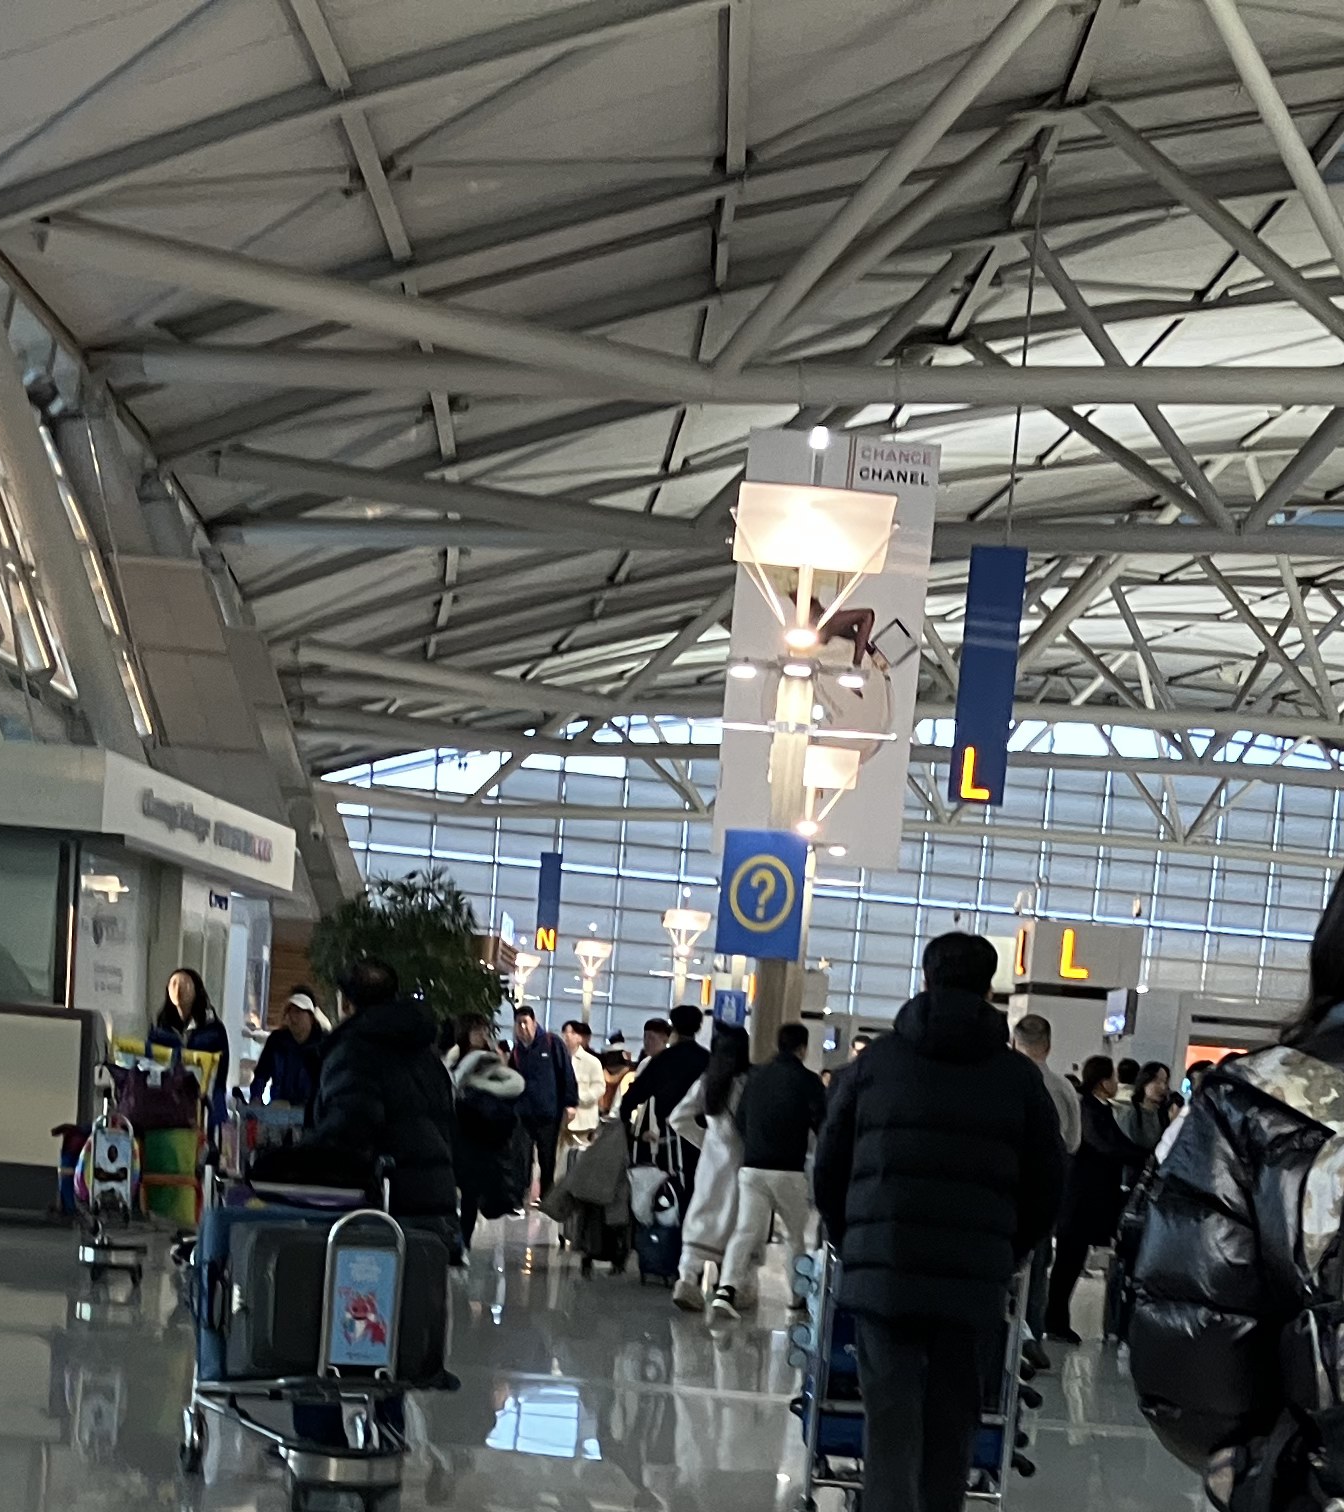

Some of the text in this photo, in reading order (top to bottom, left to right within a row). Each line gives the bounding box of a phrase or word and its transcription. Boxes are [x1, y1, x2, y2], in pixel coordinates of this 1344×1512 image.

[859, 466, 930, 486] CHANEL
[959, 746, 990, 800] L
[536, 926, 556, 952] N
[1059, 928, 1089, 979] L
